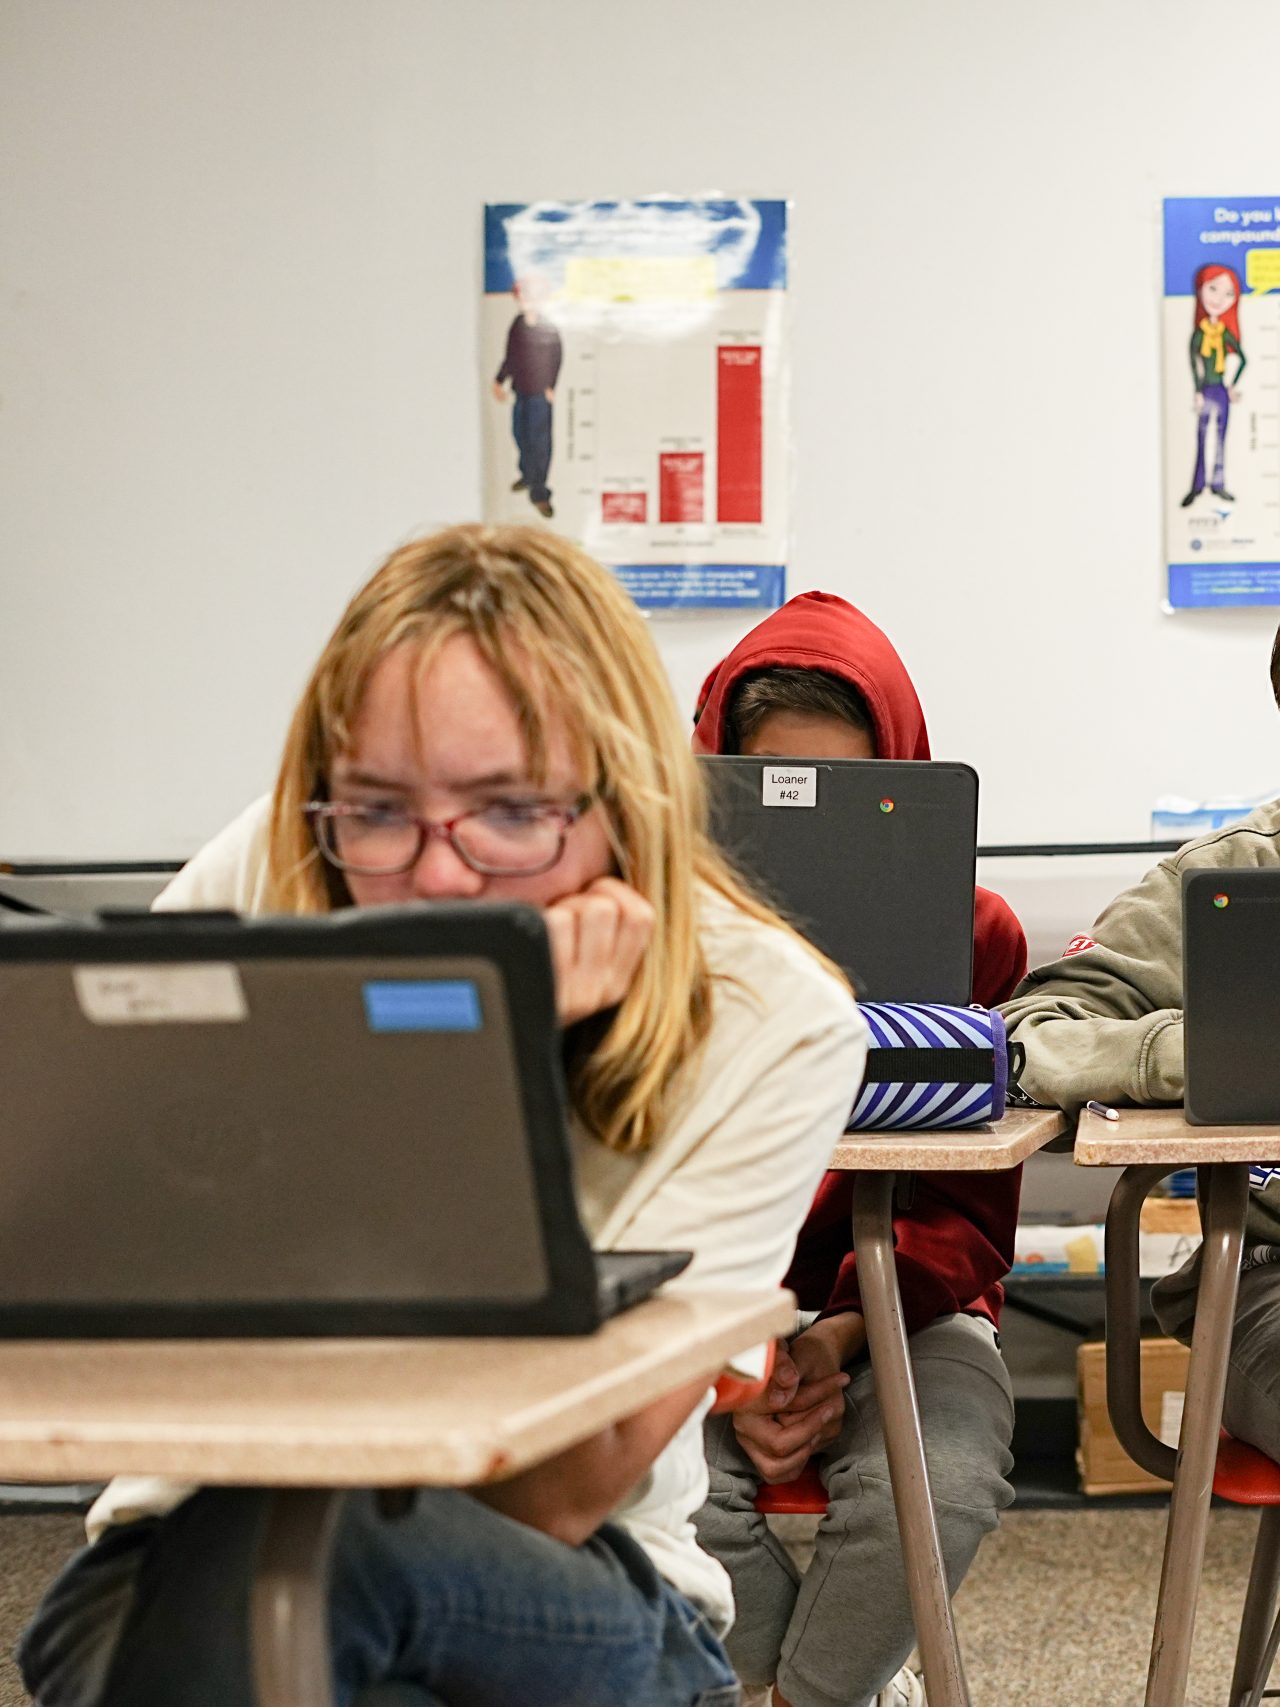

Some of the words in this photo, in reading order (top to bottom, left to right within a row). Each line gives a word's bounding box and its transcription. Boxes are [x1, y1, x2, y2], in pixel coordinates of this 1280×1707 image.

[1214, 207, 1239, 223] Do
[1240, 210, 1272, 227] you
[771, 774, 808, 784] Loaner
[779, 790, 799, 801] #42
